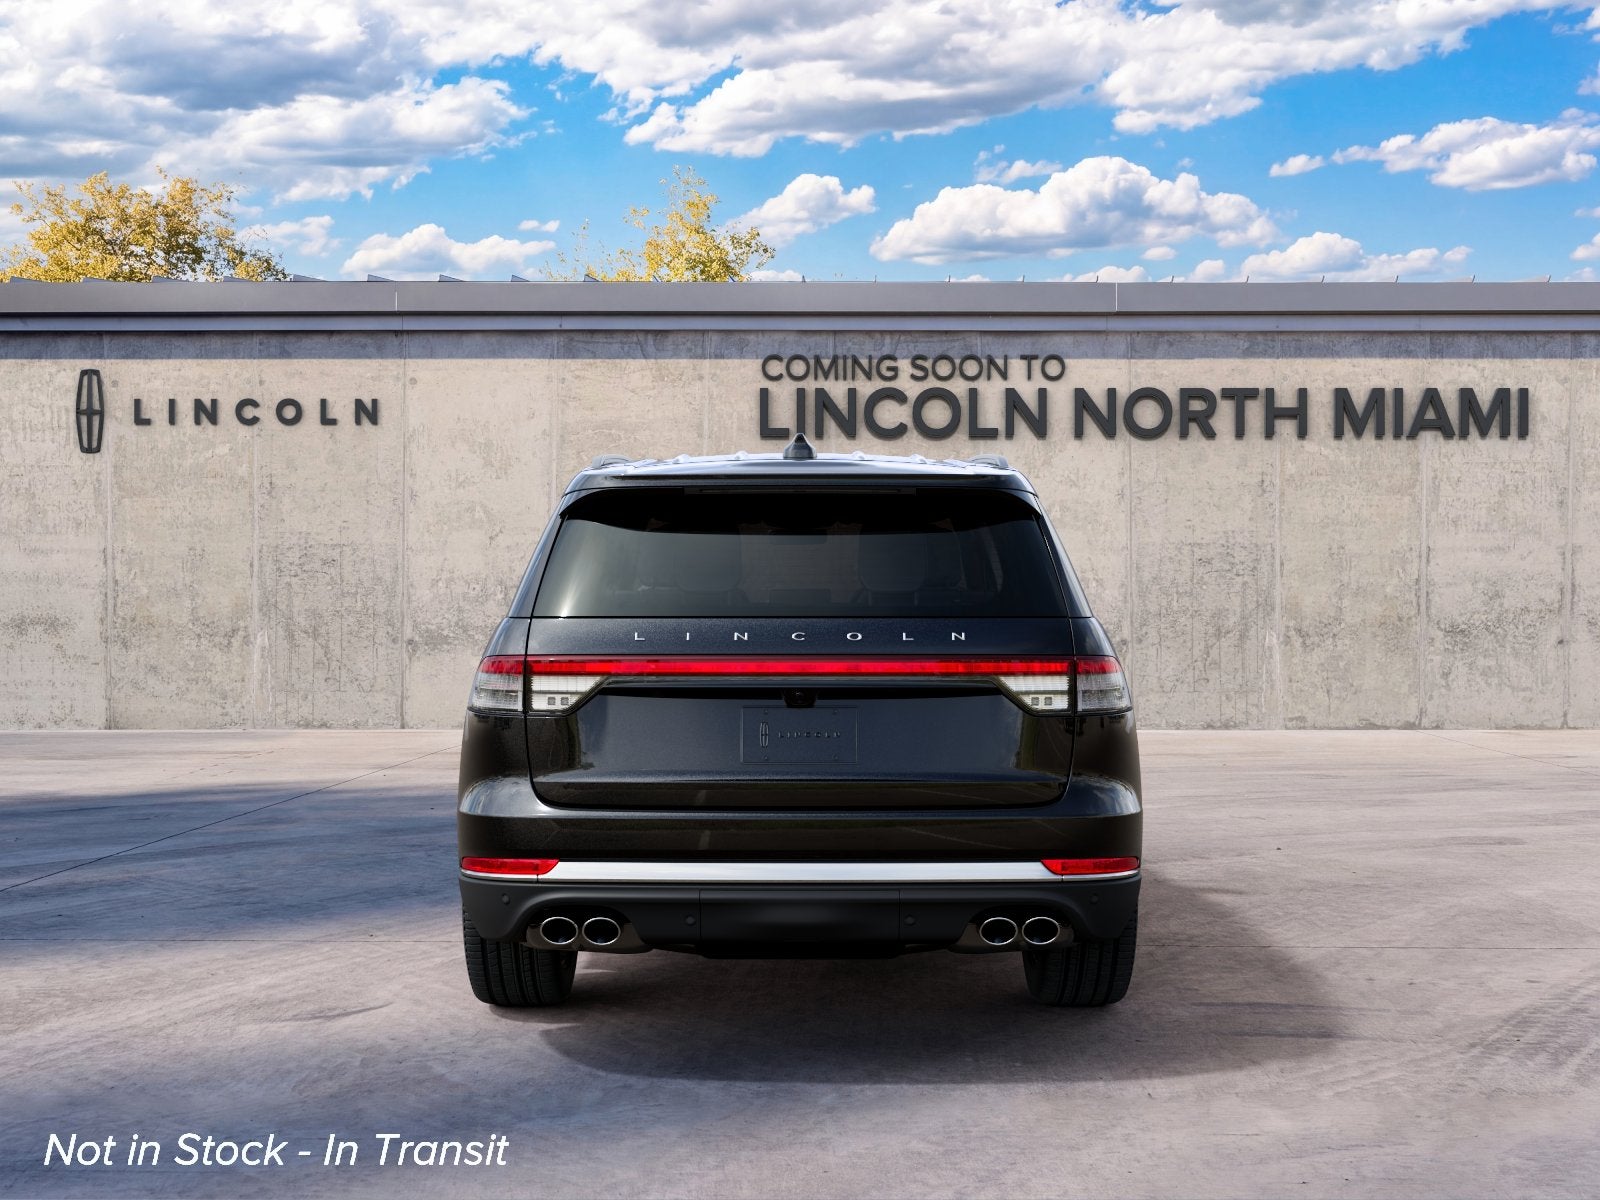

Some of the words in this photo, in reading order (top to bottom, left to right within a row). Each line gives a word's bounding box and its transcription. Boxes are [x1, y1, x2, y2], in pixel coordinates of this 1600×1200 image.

[761, 354, 900, 381] COMING
[909, 354, 1009, 381] SOON
[1021, 354, 1066, 381] TO
[133, 397, 379, 426] LINCOLN
[759, 387, 1048, 439] LINCOLN
[1073, 387, 1308, 439] NORTH
[1333, 387, 1530, 439] MIAMI
[633, 631, 966, 642] LINCOLN
